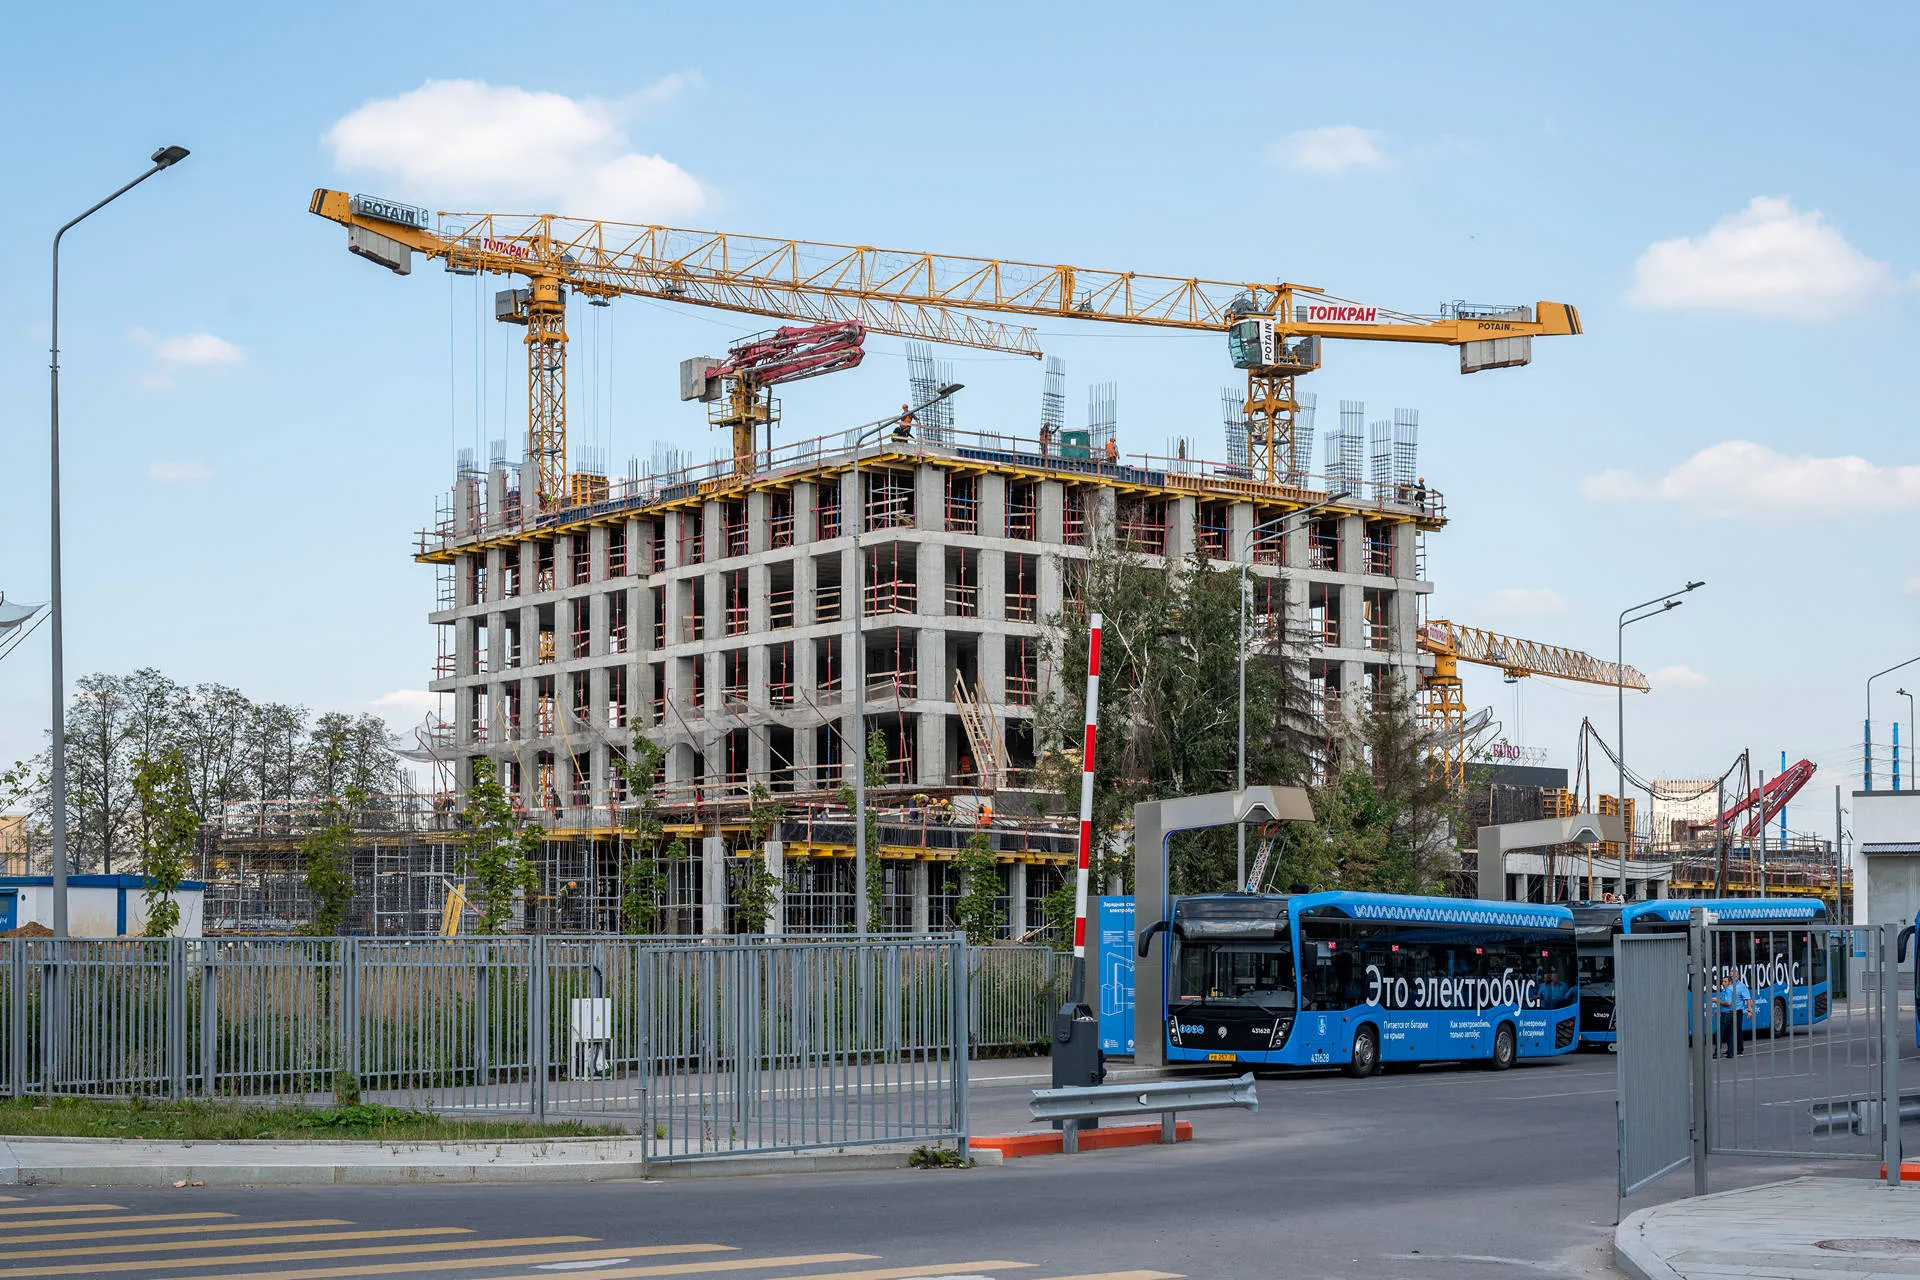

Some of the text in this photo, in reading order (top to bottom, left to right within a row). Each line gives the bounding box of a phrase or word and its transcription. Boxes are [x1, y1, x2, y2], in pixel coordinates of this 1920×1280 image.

[363, 200, 415, 224] POTAIN
[483, 237, 530, 259] ТОПКРАН
[1309, 305, 1377, 322] ТОПКРАН
[1478, 322, 1511, 331] POTAIN
[1264, 323, 1272, 361] POTAIN
[1365, 964, 1541, 1016] Это электробус.
[1311, 1053, 1330, 1063] 431628
